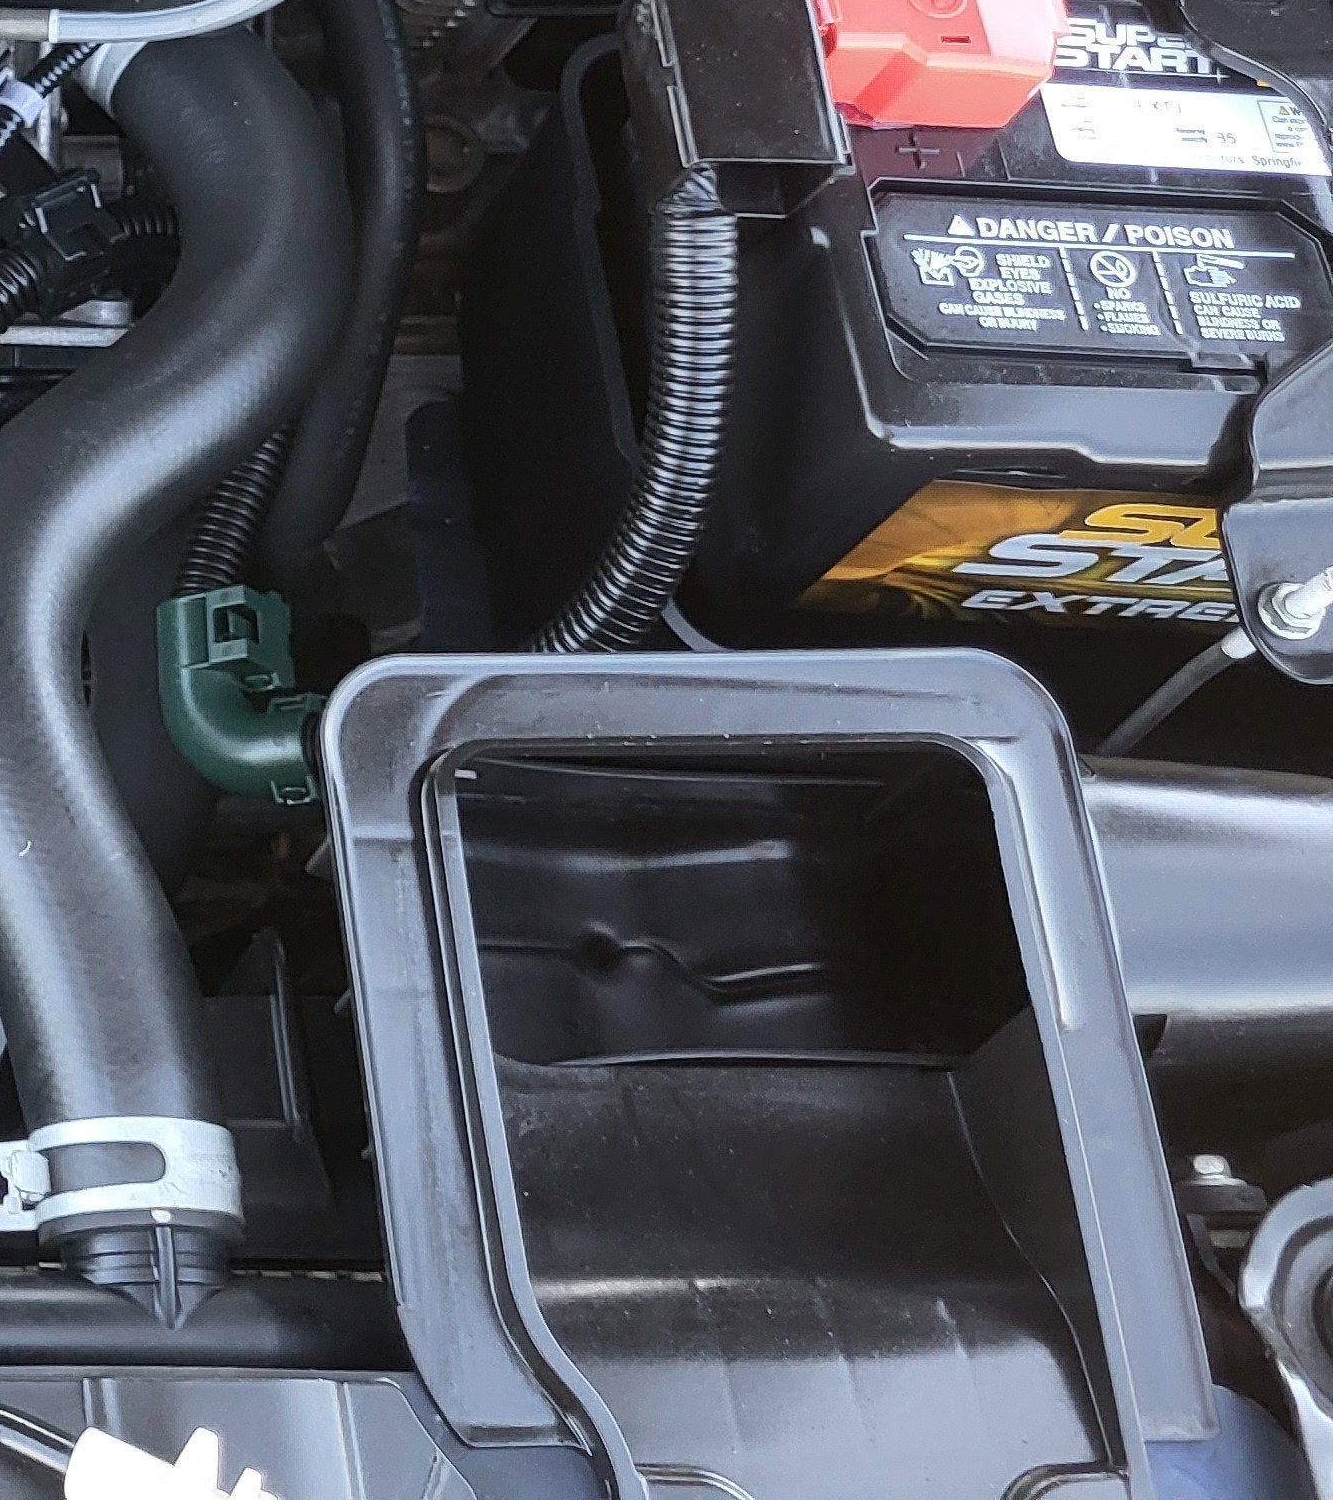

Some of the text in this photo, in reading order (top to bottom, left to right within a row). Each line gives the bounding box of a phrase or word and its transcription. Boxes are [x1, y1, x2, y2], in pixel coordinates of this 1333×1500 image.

[975, 216, 1098, 243] DANGER
[1123, 224, 1235, 249] POISON
[995, 253, 1052, 268] SHIELD
[999, 267, 1041, 281] EYES
[968, 278, 1053, 295] EXPLOSIVE
[1105, 286, 1132, 300] NO
[971, 291, 1025, 306] GASES
[1188, 291, 1302, 309] SULFURIC ACID
[1100, 300, 1148, 313] SPARKS
[1192, 304, 1262, 319] CAN CAUSE
[1197, 315, 1282, 331] BLINDNESS OR
[1200, 327, 1286, 343] SEVERE BURNS
